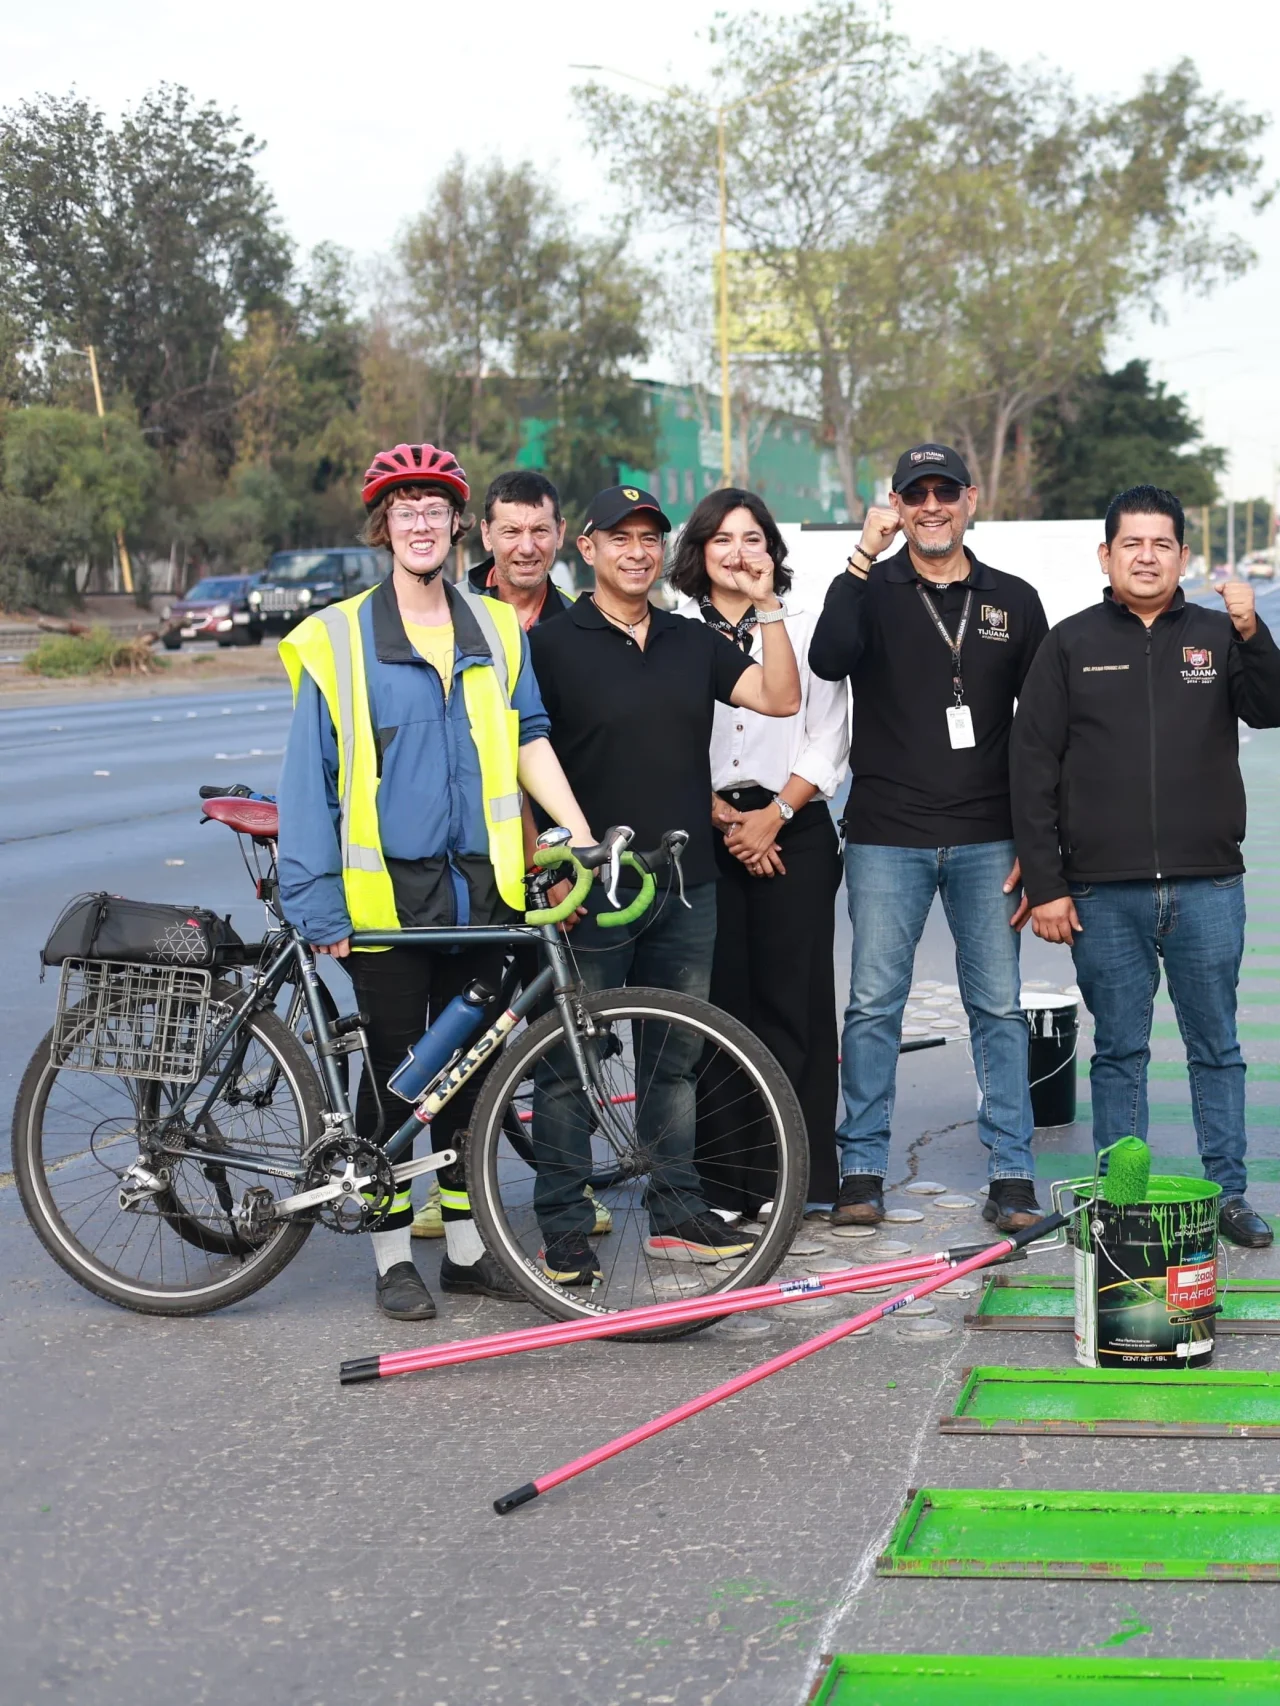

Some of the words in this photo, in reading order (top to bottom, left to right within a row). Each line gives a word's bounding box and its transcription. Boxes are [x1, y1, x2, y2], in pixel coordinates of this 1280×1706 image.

[977, 628, 1010, 639] TIJUANA
[1180, 669, 1218, 678] TIJUANA
[434, 1026, 504, 1101] MASI
